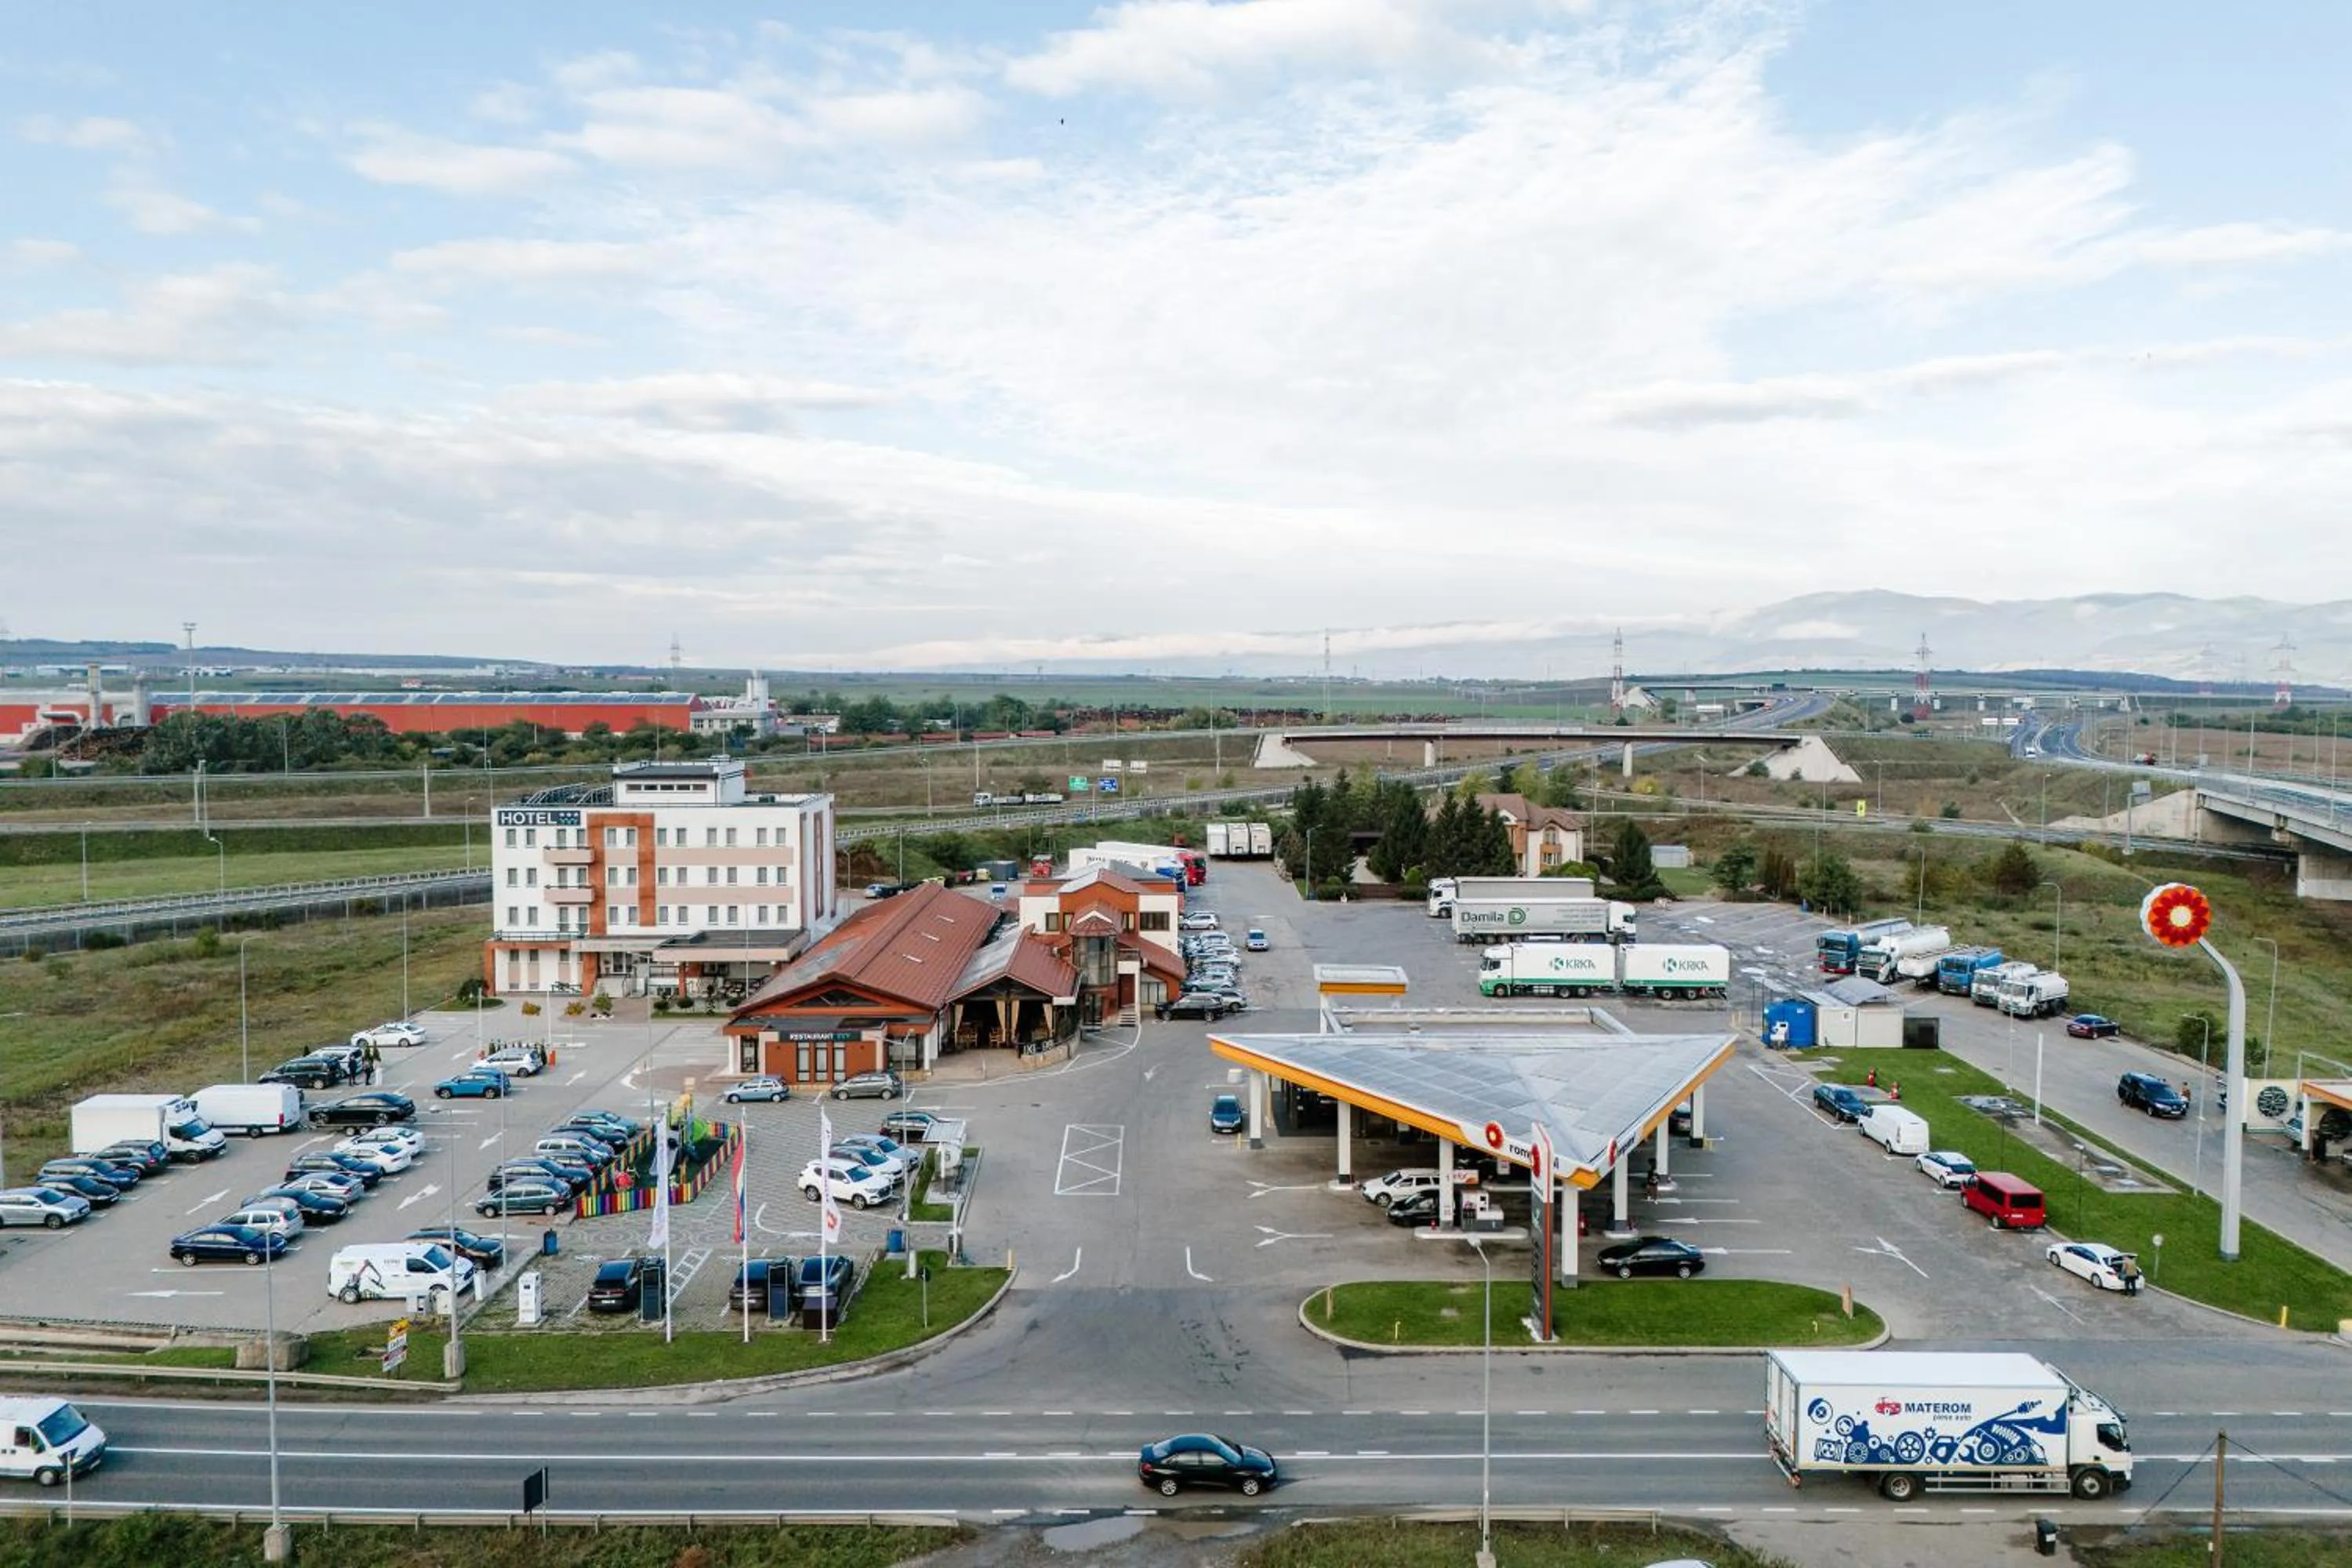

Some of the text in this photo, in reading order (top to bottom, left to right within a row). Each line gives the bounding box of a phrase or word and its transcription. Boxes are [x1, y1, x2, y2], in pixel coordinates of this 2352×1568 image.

[502, 812, 557, 824] HOTEL
[1461, 912, 1504, 923] Damila
[1566, 959, 1596, 969] KRKA
[1679, 960, 1709, 970] KRKA
[789, 1033, 833, 1041] RESTAURANT
[1904, 1403, 1972, 1414] MATEROM
